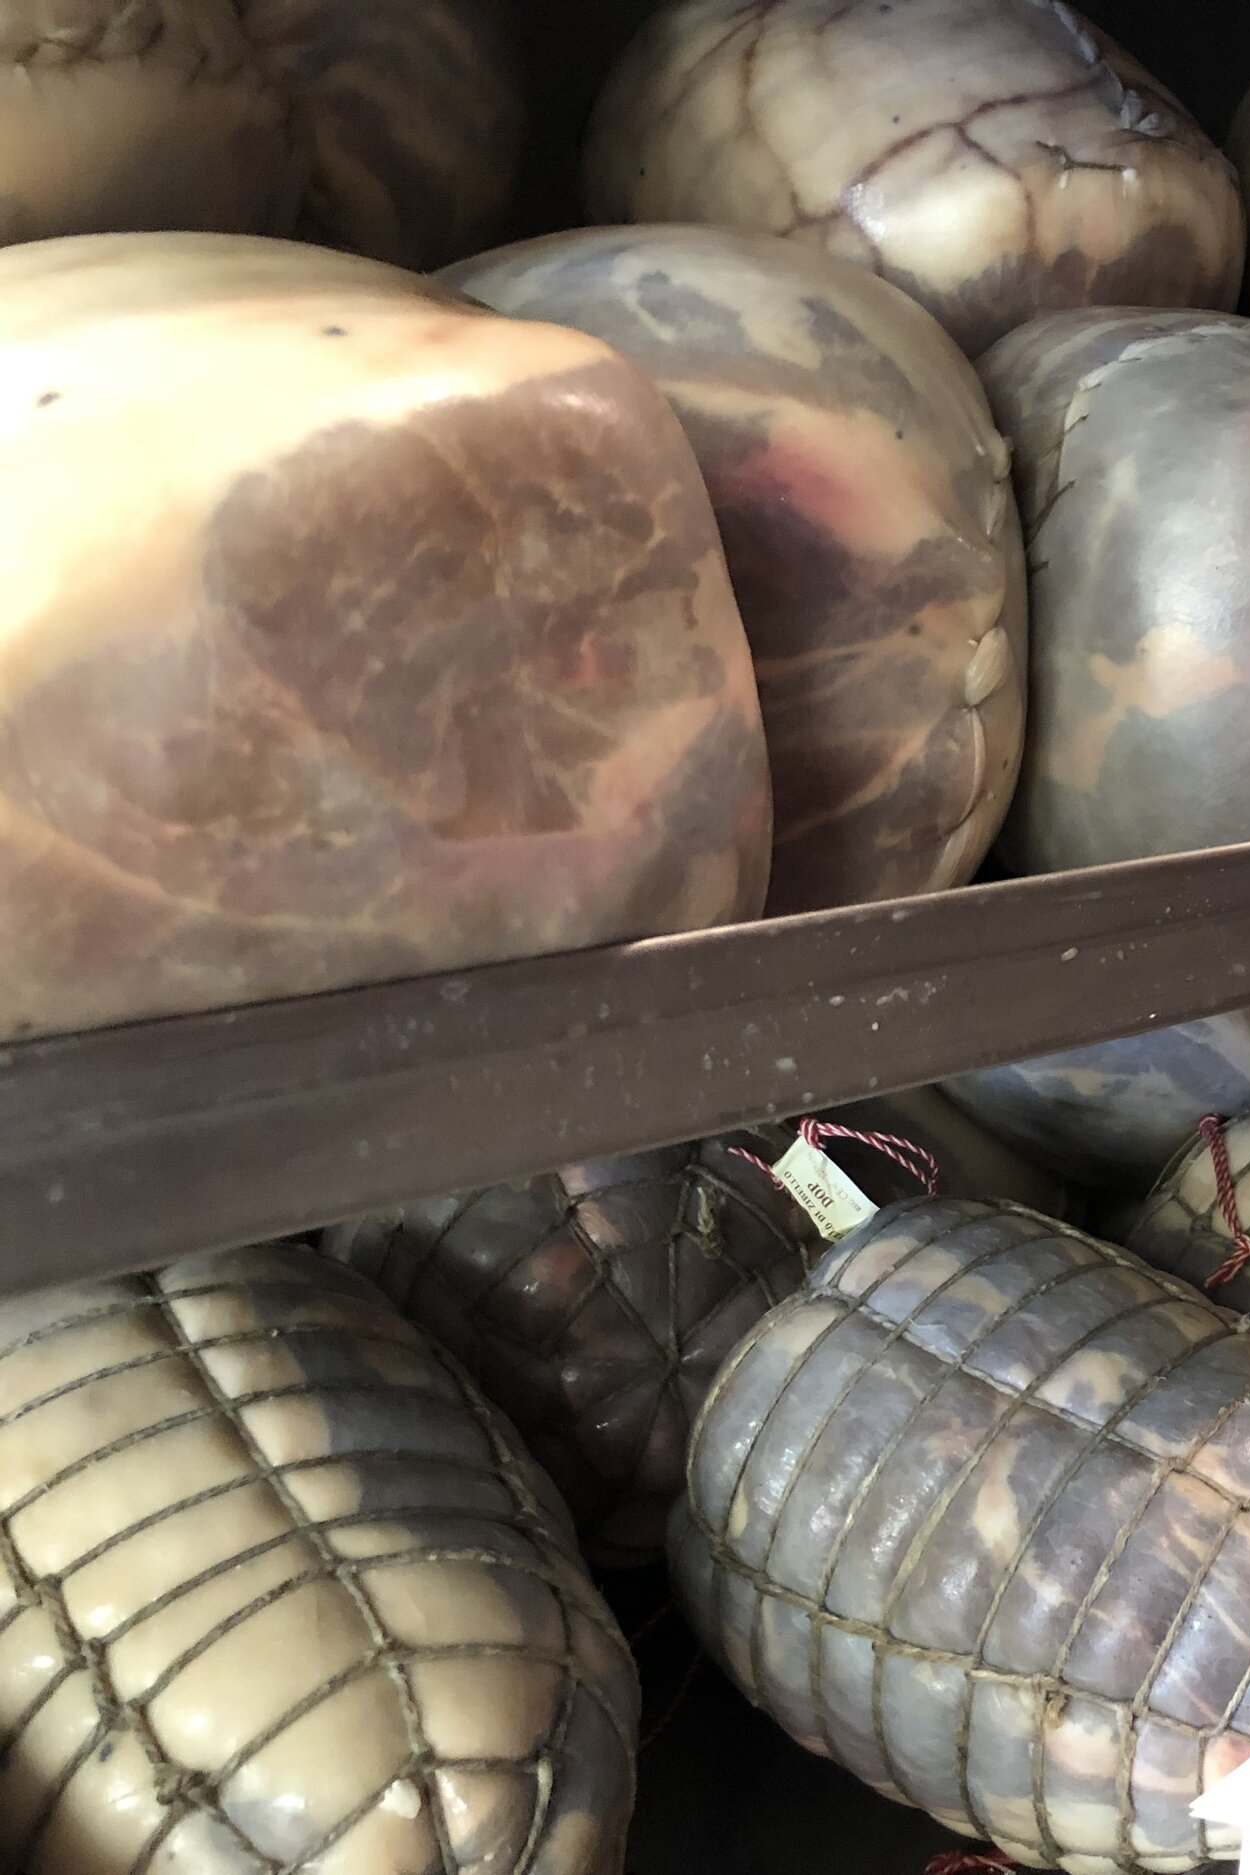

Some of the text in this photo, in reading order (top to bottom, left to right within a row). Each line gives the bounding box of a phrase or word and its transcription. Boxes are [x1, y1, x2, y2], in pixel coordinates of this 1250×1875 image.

[784, 1171, 816, 1211] ZIBELLO
[806, 1182, 835, 1208] DOP
[813, 1211, 826, 1223] DI
